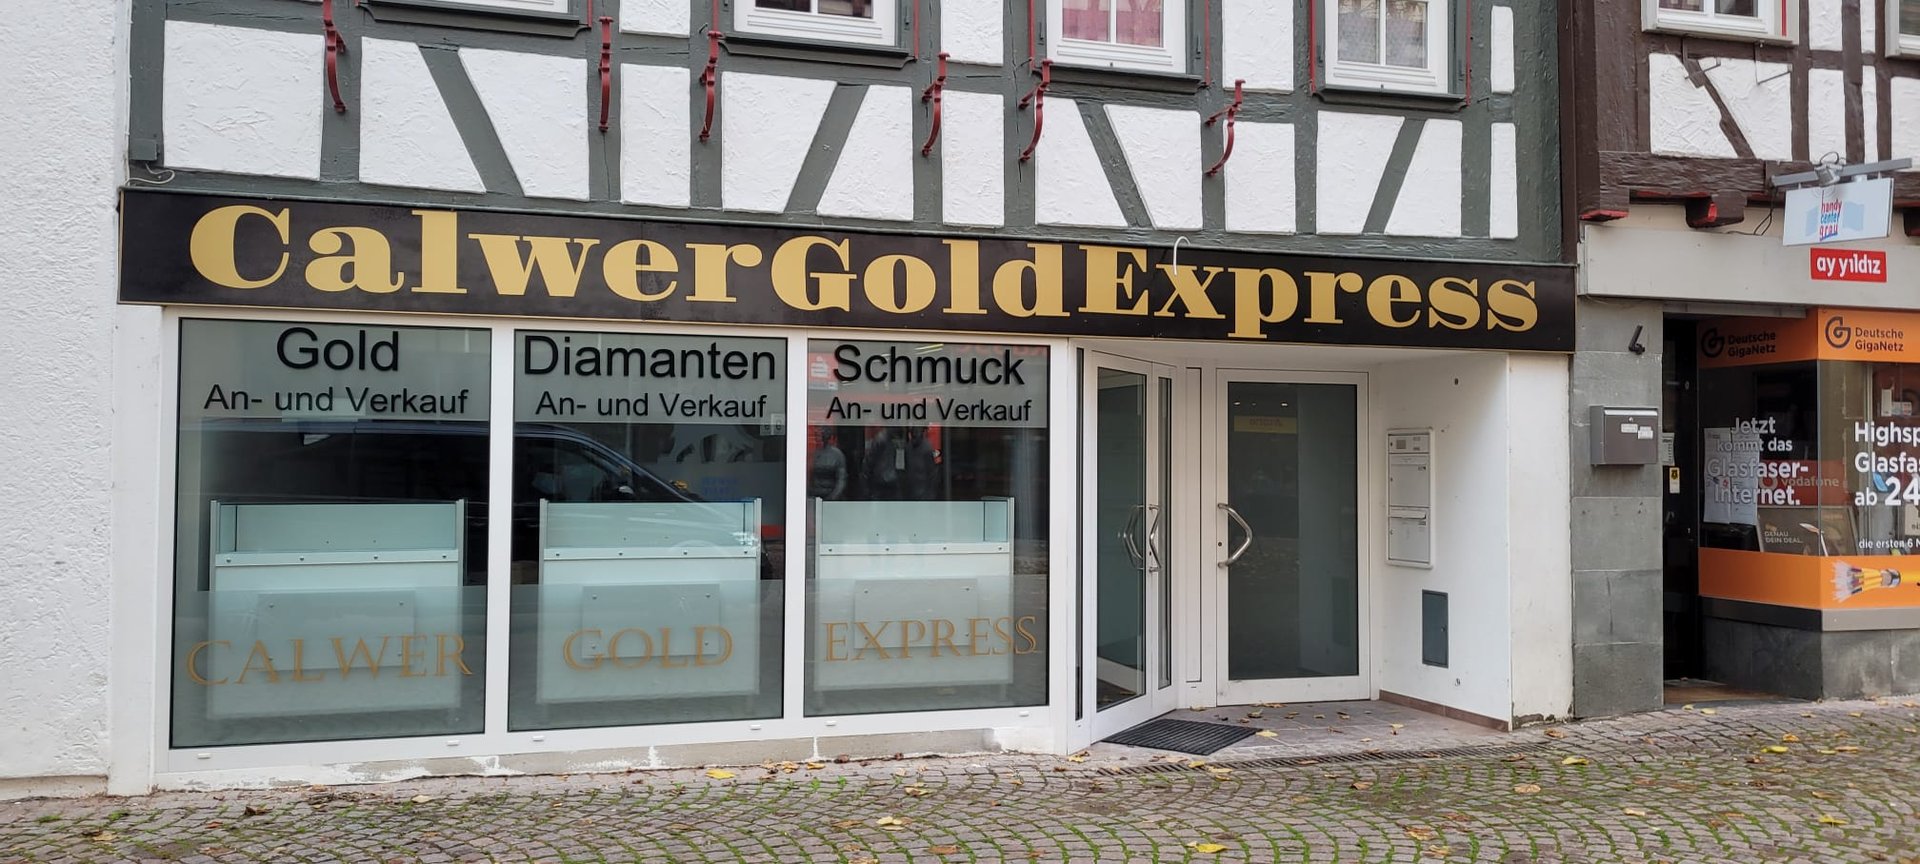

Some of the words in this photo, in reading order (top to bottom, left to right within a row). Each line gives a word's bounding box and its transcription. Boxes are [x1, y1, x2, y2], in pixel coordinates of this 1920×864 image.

[1821, 191, 1842, 212] handy
[1821, 212, 1840, 224] center
[1820, 224, 1838, 241] grau
[189, 204, 1539, 339] CalwerGoldExpress
[1816, 256, 1836, 277] ay
[1728, 331, 1776, 346] Deutsche
[1855, 326, 1904, 339] Deutsche
[276, 327, 399, 371] Gold
[1728, 343, 1776, 358] GigaNetz
[1855, 340, 1904, 352] GigaNetz
[524, 335, 775, 380] Diamanten
[833, 344, 1025, 386] Schmuck
[203, 384, 263, 410] An-
[275, 387, 334, 412] und
[346, 387, 469, 414] Verkauf
[535, 390, 586, 415] An-
[597, 392, 649, 417] und
[659, 392, 767, 418] Verkauf
[826, 396, 871, 419] An-
[881, 398, 927, 420] und
[936, 398, 1032, 421] Verkauf
[1730, 416, 1776, 434] Jetzt
[1716, 437, 1764, 452] kommt
[1767, 437, 1793, 451] das
[1707, 459, 1809, 478] Glasfaser-
[1854, 451, 1920, 474] Glasfa
[1781, 476, 1840, 488] vodafone
[1714, 485, 1801, 505] Internet.
[1854, 487, 1877, 506] ab
[1858, 538, 1873, 549] die
[1876, 538, 1905, 549] ersten
[1907, 538, 1914, 549] 6
[562, 625, 733, 672] GOLD
[823, 615, 1038, 662] EXPRESS
[186, 634, 475, 686] CALWER
